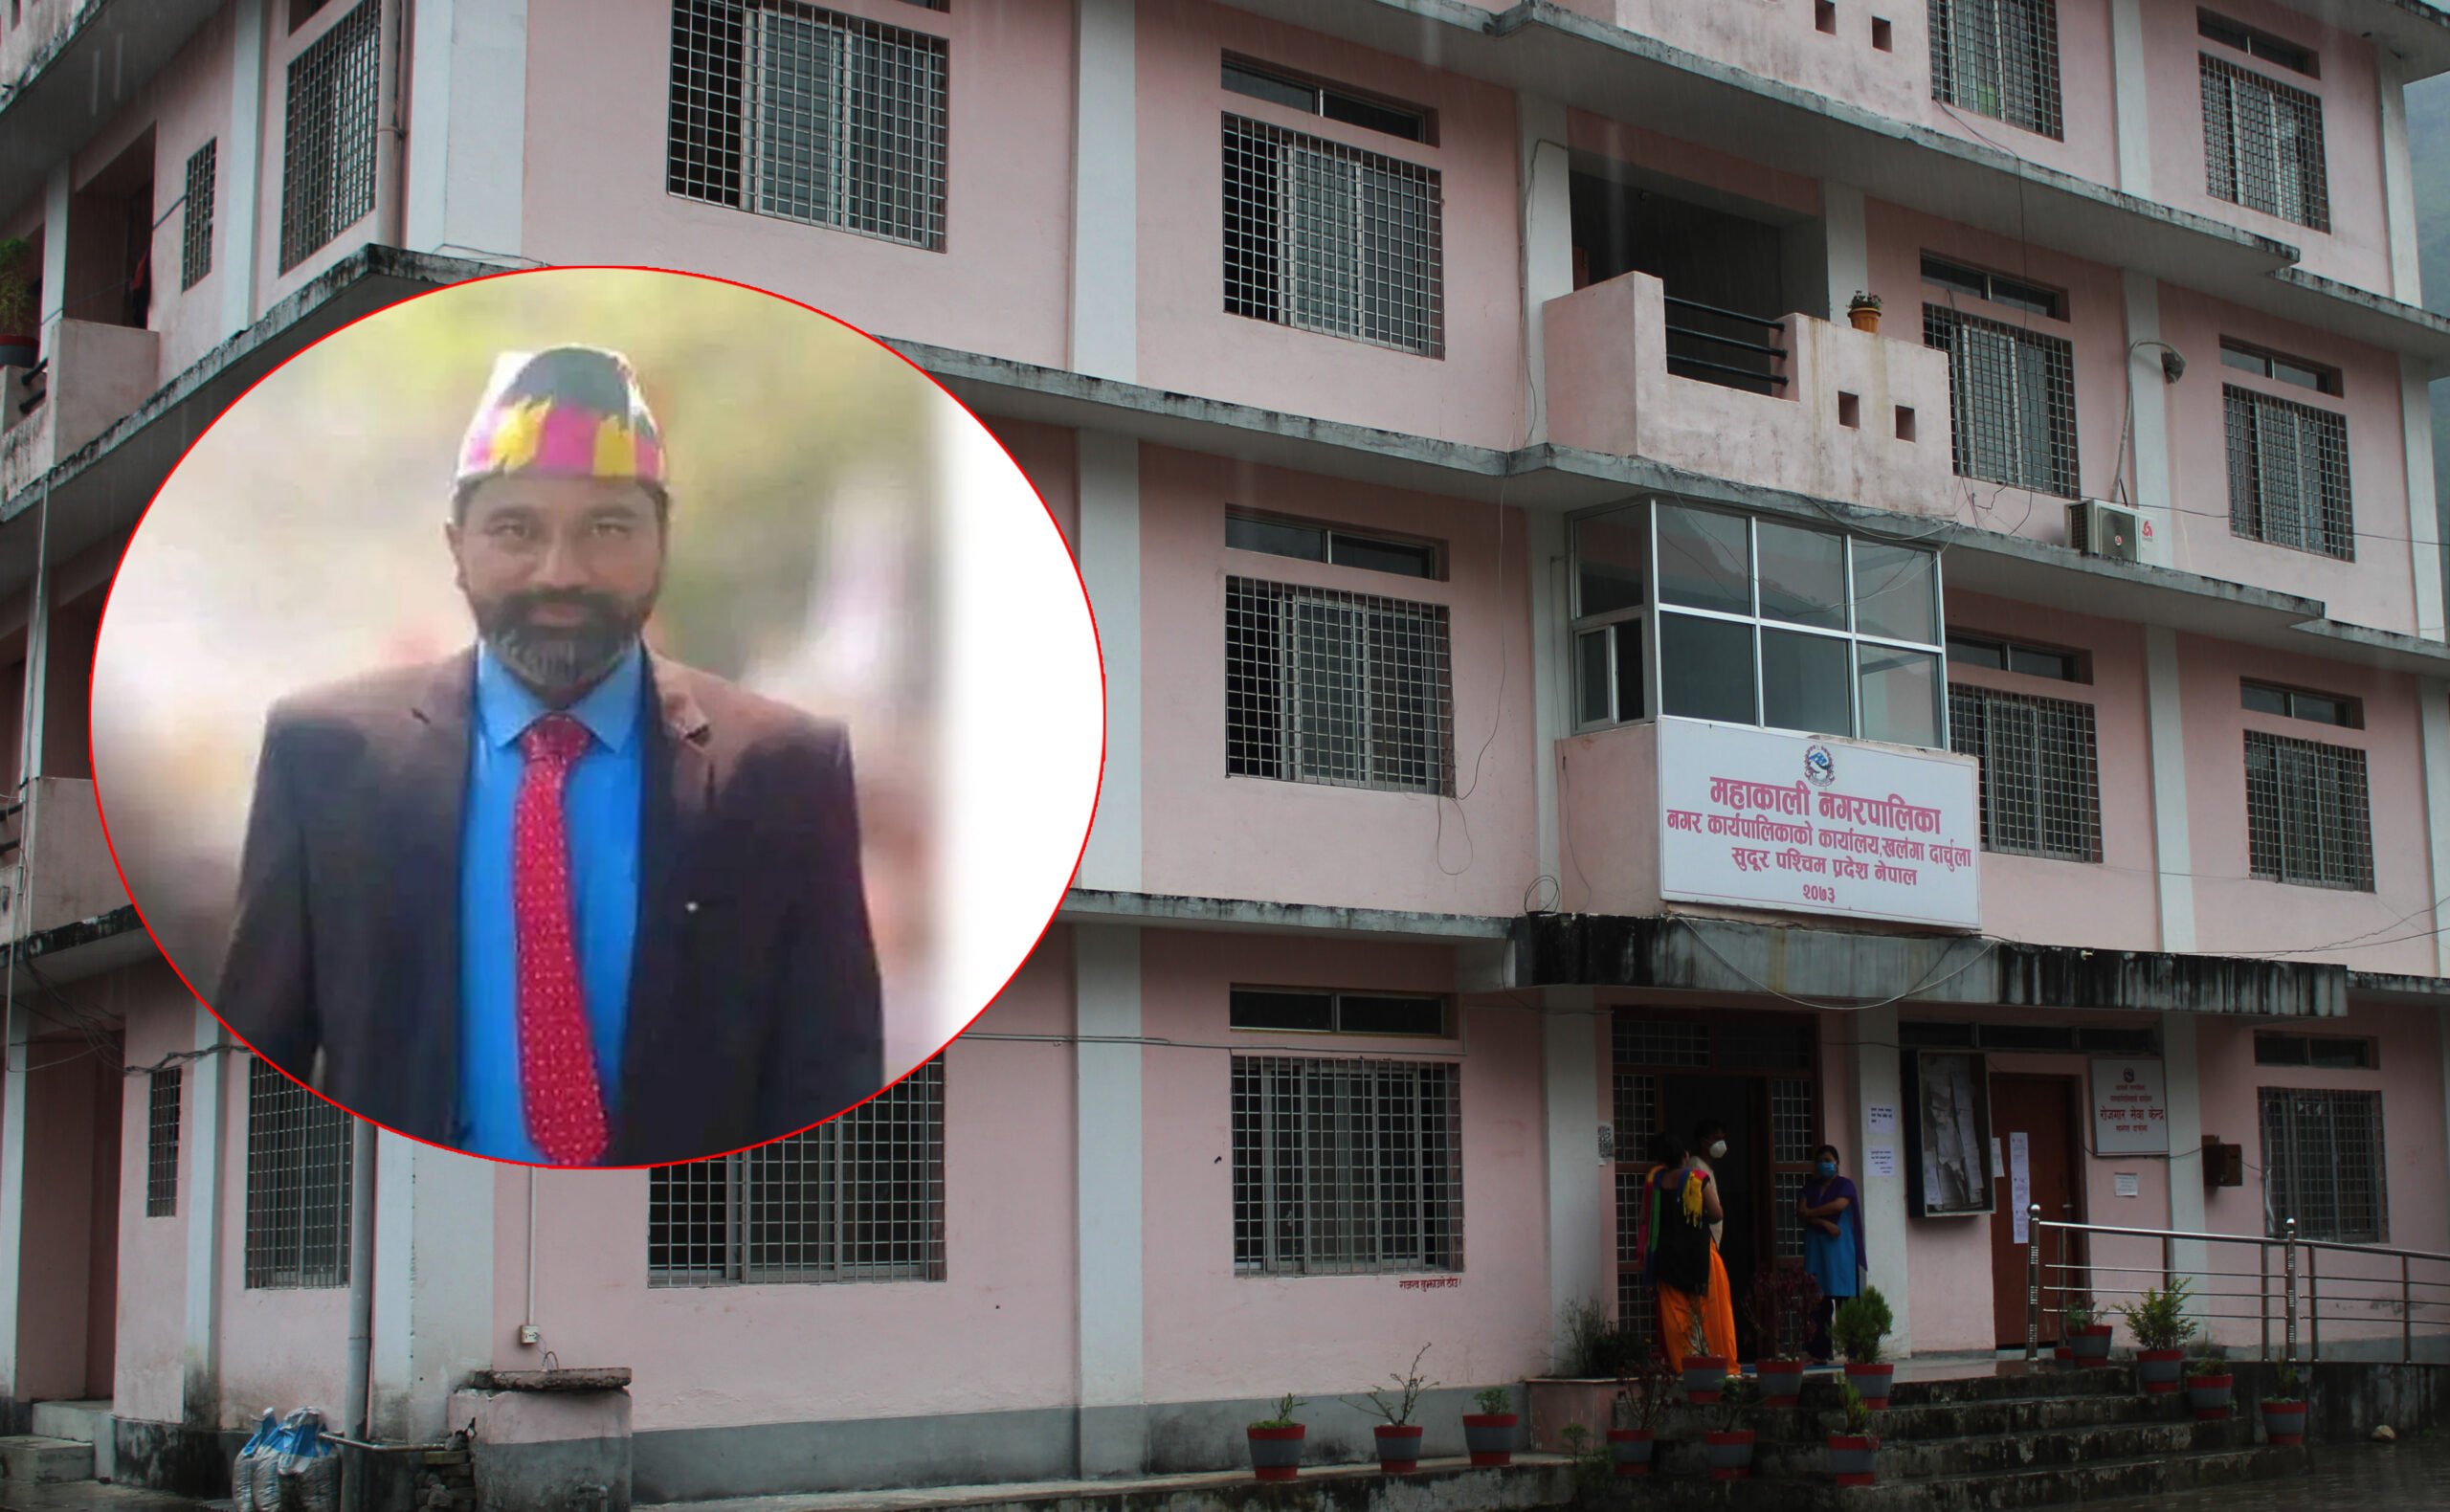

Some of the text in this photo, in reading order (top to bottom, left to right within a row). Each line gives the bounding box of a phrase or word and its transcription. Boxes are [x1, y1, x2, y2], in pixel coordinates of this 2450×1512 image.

[1709, 776, 1941, 835] महाकाली नगरपालिका
[1666, 809, 1703, 834] नगर
[1707, 812, 1814, 846] कार्यपालिकाको
[1928, 838, 1971, 872] दार्चुला
[1775, 848, 1827, 875] पश्चिम
[1832, 856, 1869, 880] प्रदेश
[1874, 860, 1918, 886] नेपाल
[1802, 884, 1836, 904] २०७३
[2100, 1104, 2165, 1122] रोजगार सेवा केन्द्र
